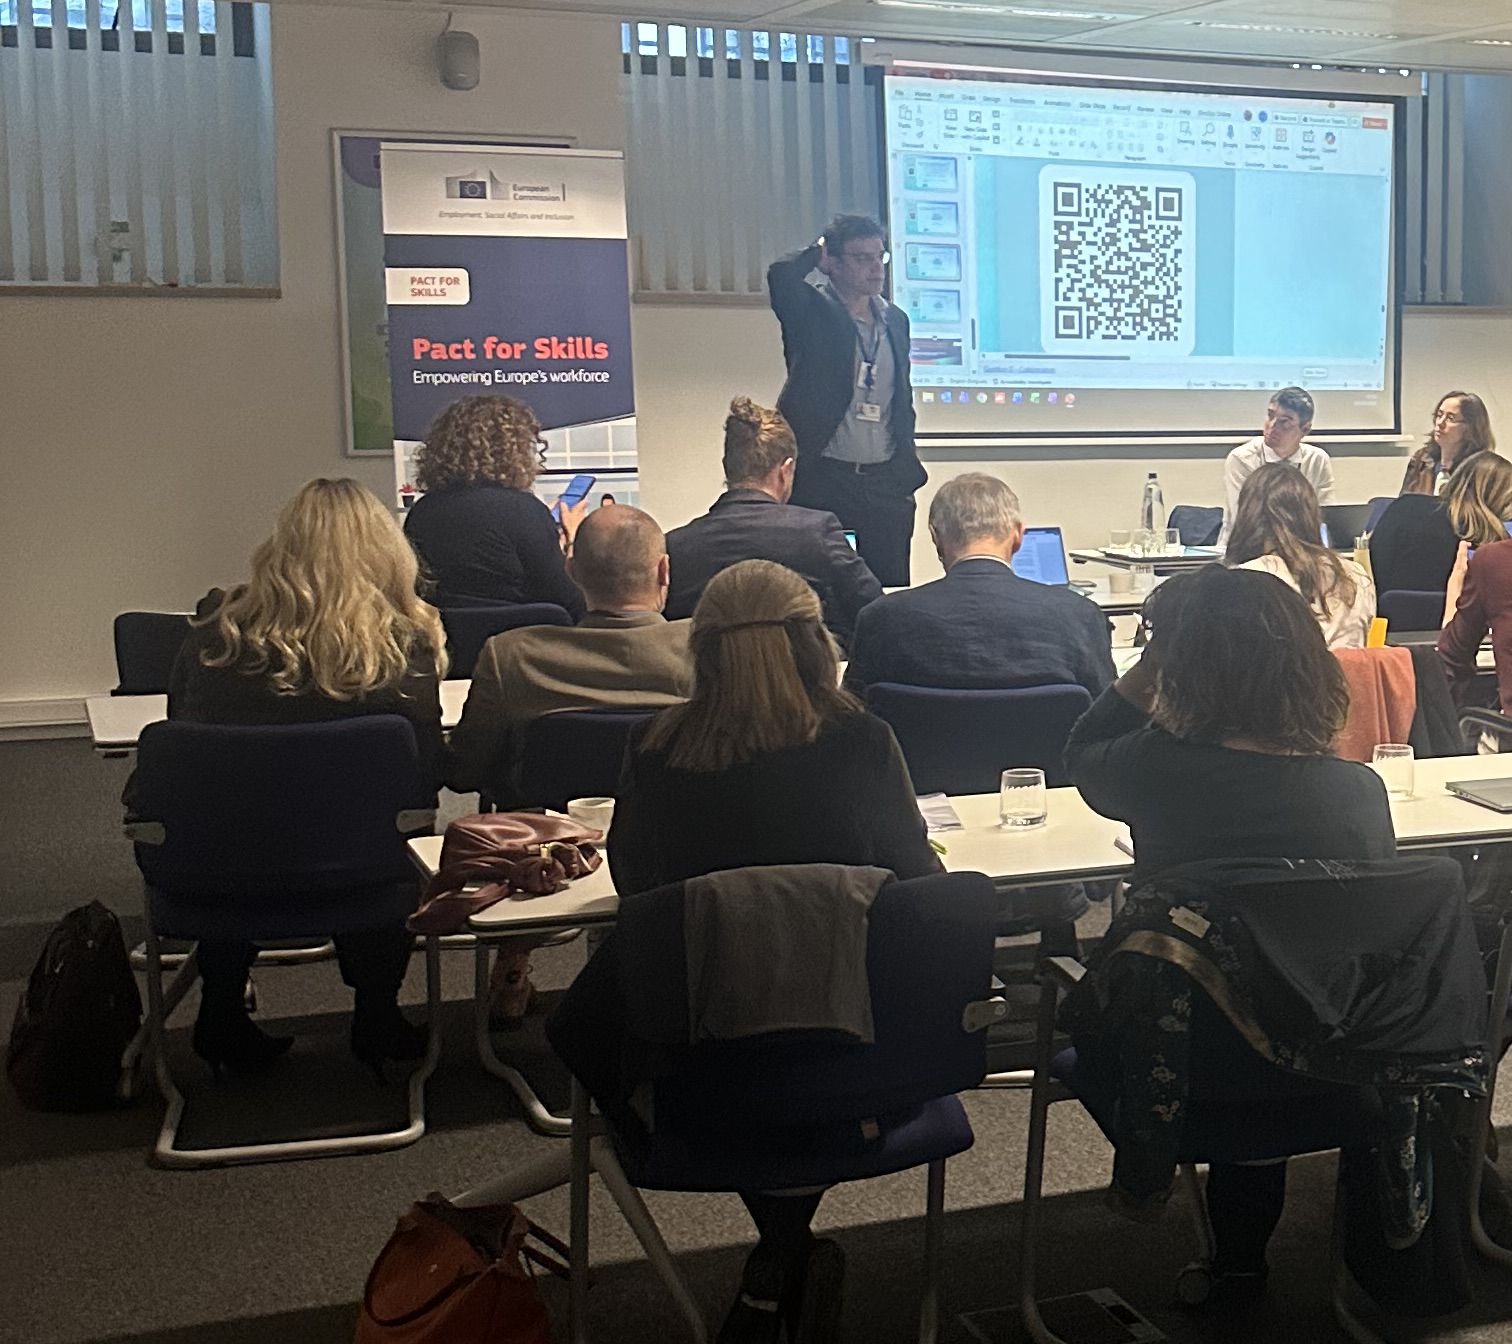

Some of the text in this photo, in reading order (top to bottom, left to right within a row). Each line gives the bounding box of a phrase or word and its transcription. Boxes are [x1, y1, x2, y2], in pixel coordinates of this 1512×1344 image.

[410, 276, 460, 286] PACT FOR
[410, 288, 447, 297] SKILLS
[412, 335, 610, 360] Pact for Skills
[412, 368, 610, 386] Empowering Europe's workforce
